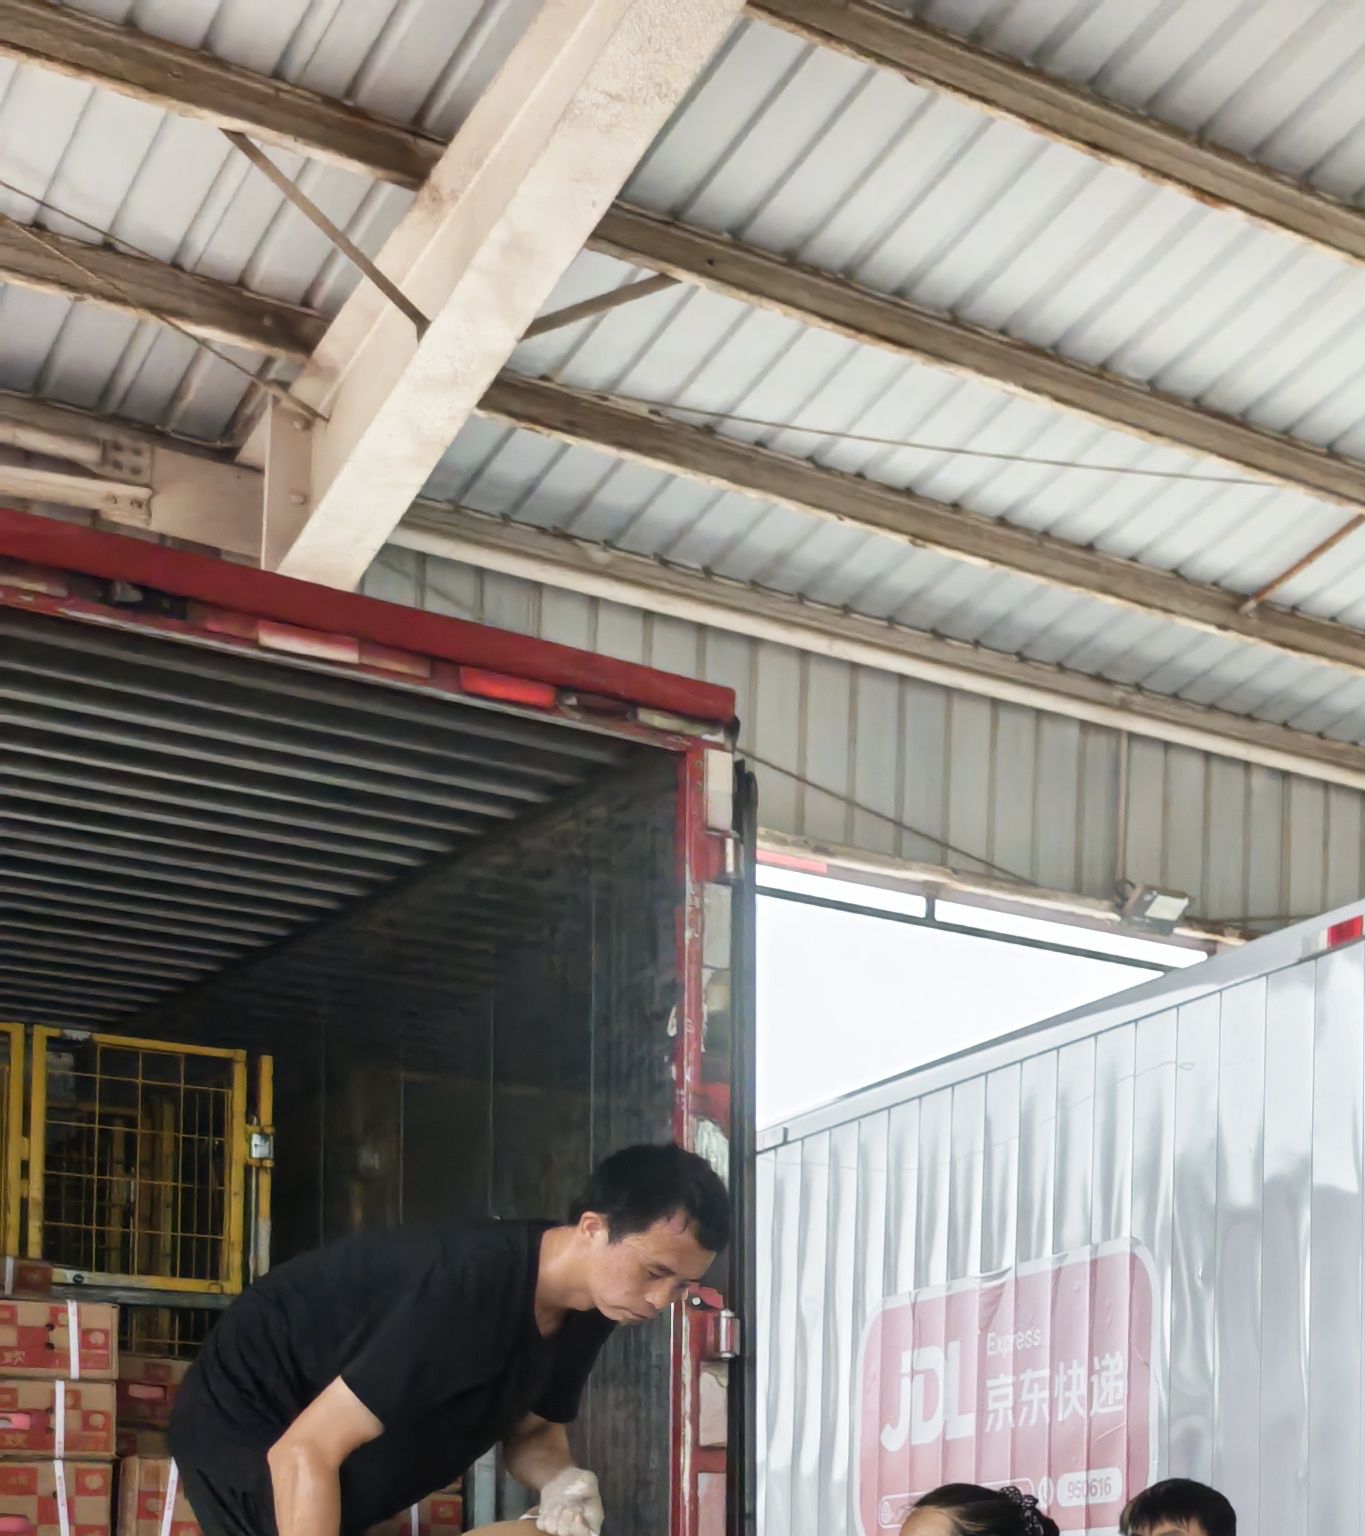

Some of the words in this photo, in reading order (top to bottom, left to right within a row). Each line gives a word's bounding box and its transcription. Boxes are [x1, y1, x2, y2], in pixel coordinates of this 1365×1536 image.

[987, 1327, 1041, 1357] Express
[880, 1340, 975, 1453] JDL
[986, 1351, 1126, 1433] 京东快递
[1067, 1477, 1112, 1499] 950616
